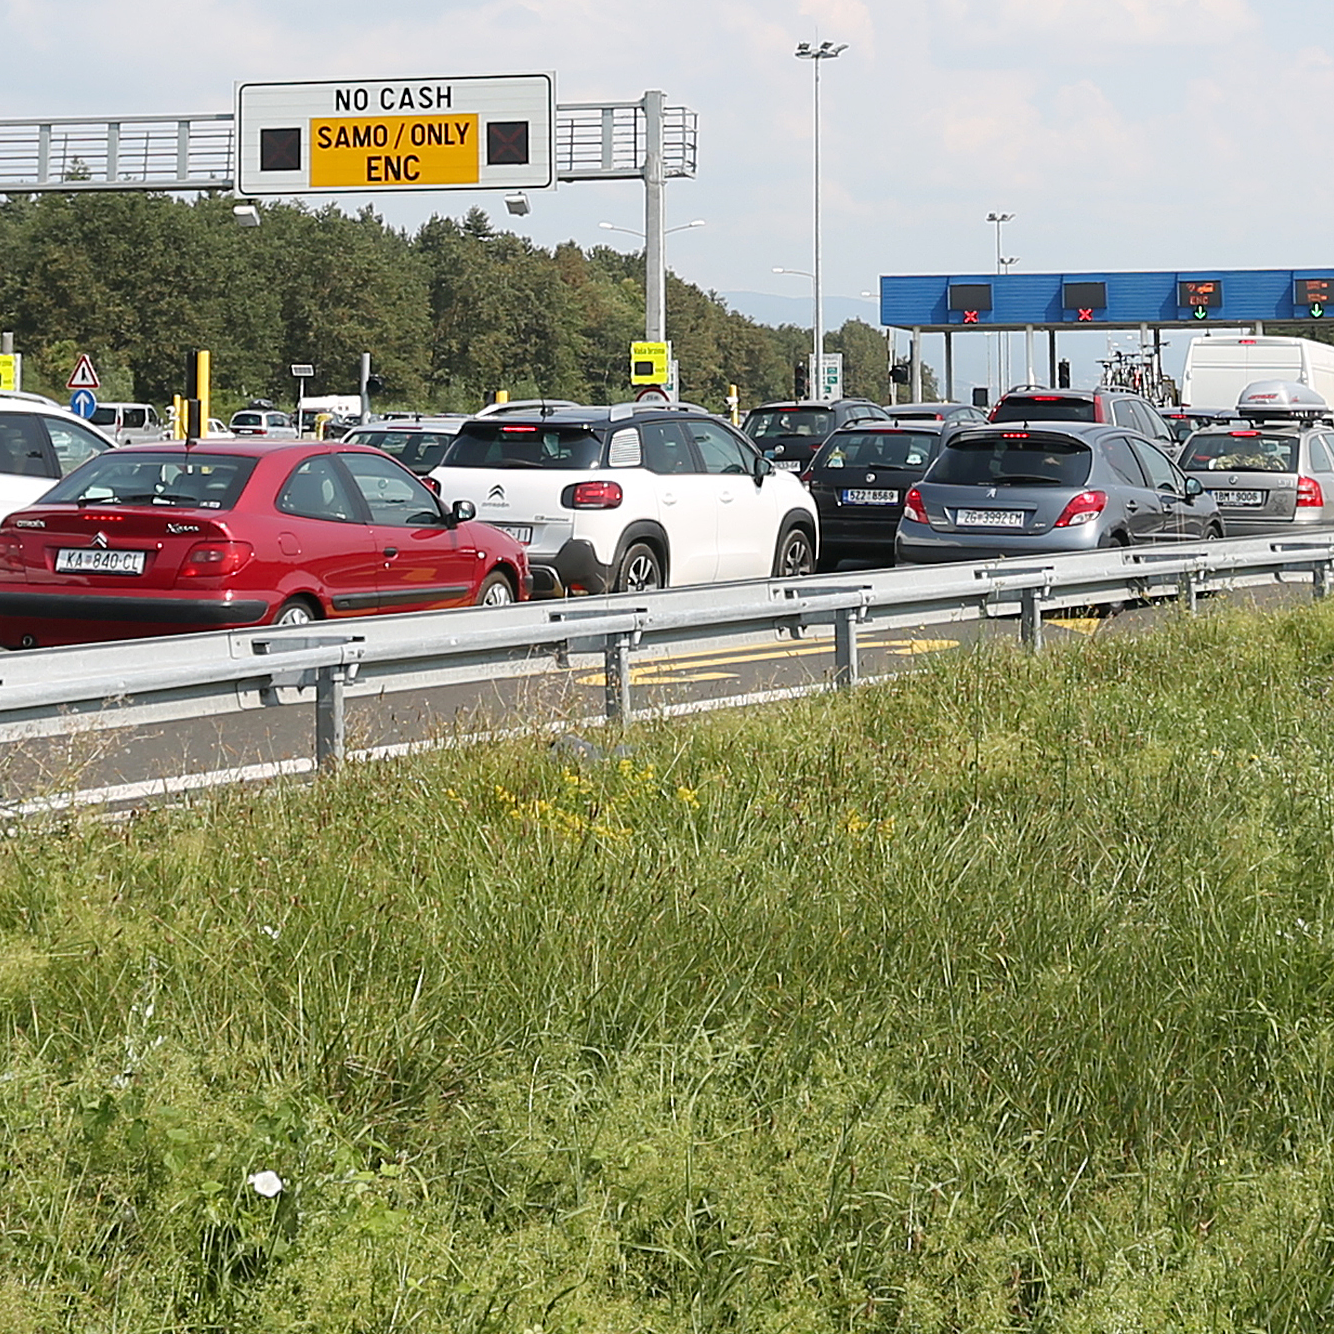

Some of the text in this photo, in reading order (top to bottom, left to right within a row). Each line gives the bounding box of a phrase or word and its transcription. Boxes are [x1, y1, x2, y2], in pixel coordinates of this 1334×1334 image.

[335, 86, 452, 112] NO CASH
[317, 124, 388, 149] SAMO
[411, 121, 470, 147] ONLY
[366, 154, 421, 182] ENC
[1189, 295, 1209, 306] ENC
[67, 552, 83, 568] KA
